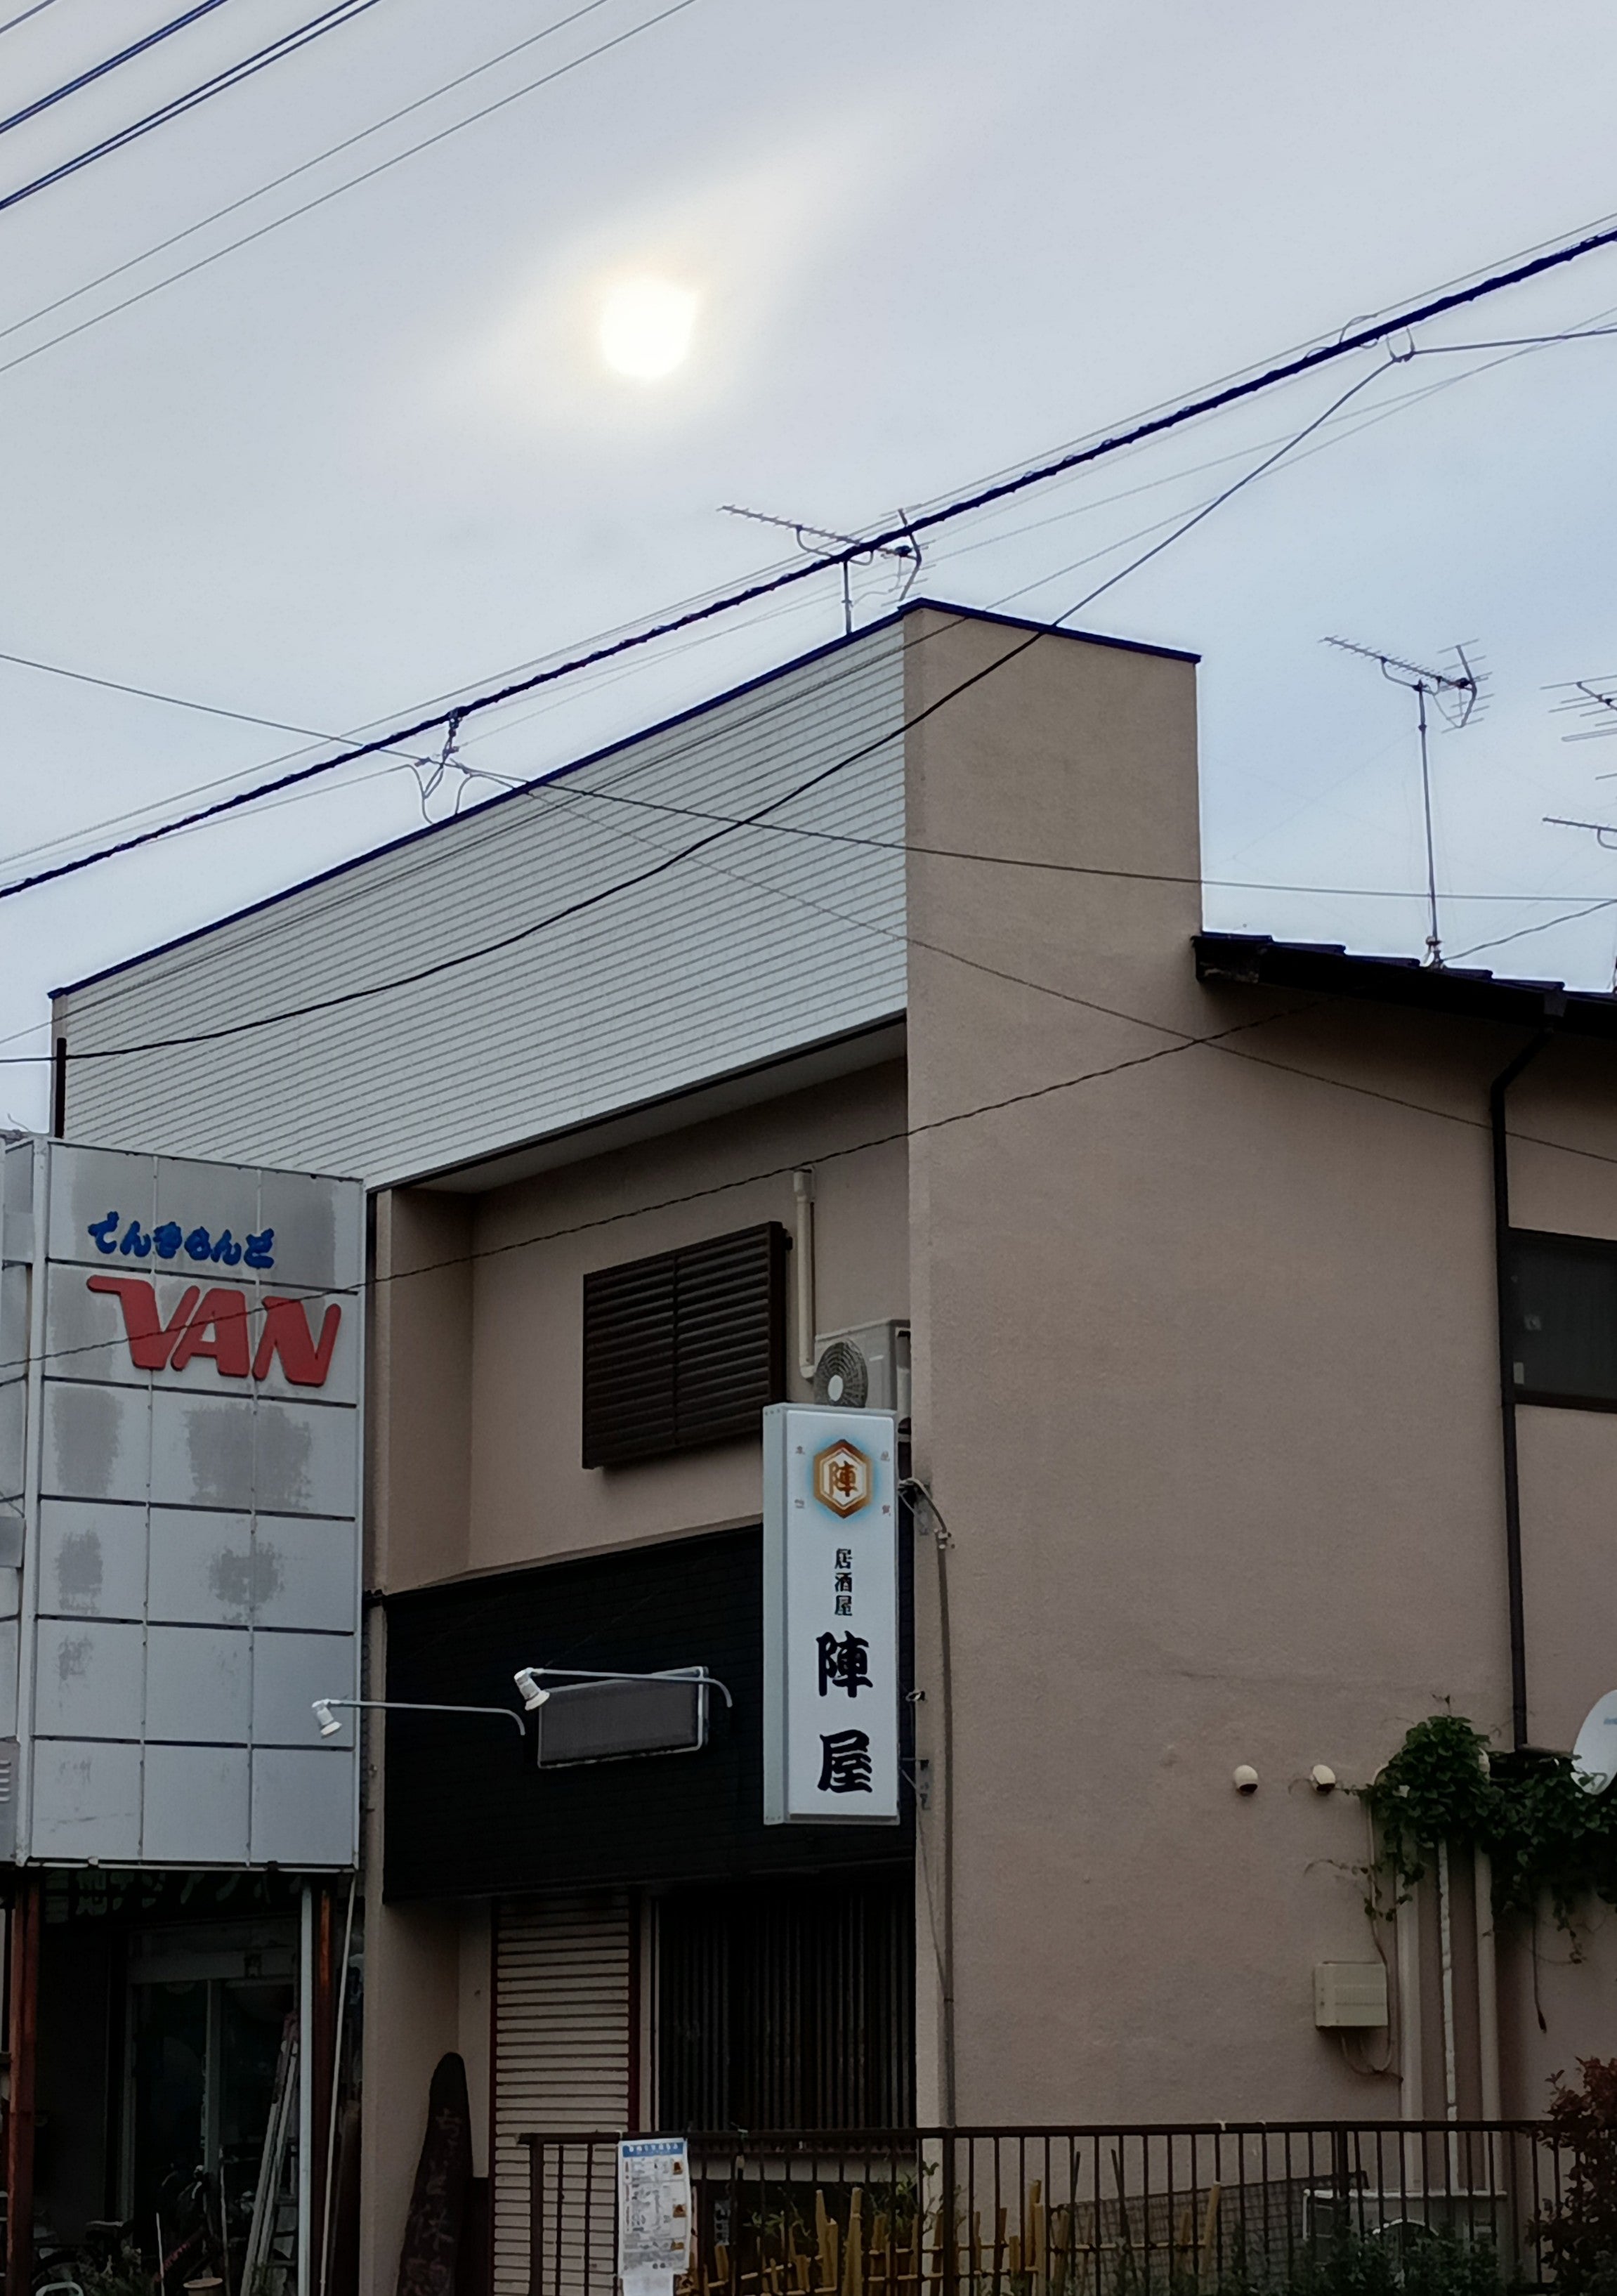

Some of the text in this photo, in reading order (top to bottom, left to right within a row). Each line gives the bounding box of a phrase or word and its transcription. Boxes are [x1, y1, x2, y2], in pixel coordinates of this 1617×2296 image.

[86, 1274, 342, 1388] VAN
[827, 1460, 859, 1497] 陣
[834, 1548, 853, 1616] 居酒屋
[816, 1630, 874, 1794] 陣屋
